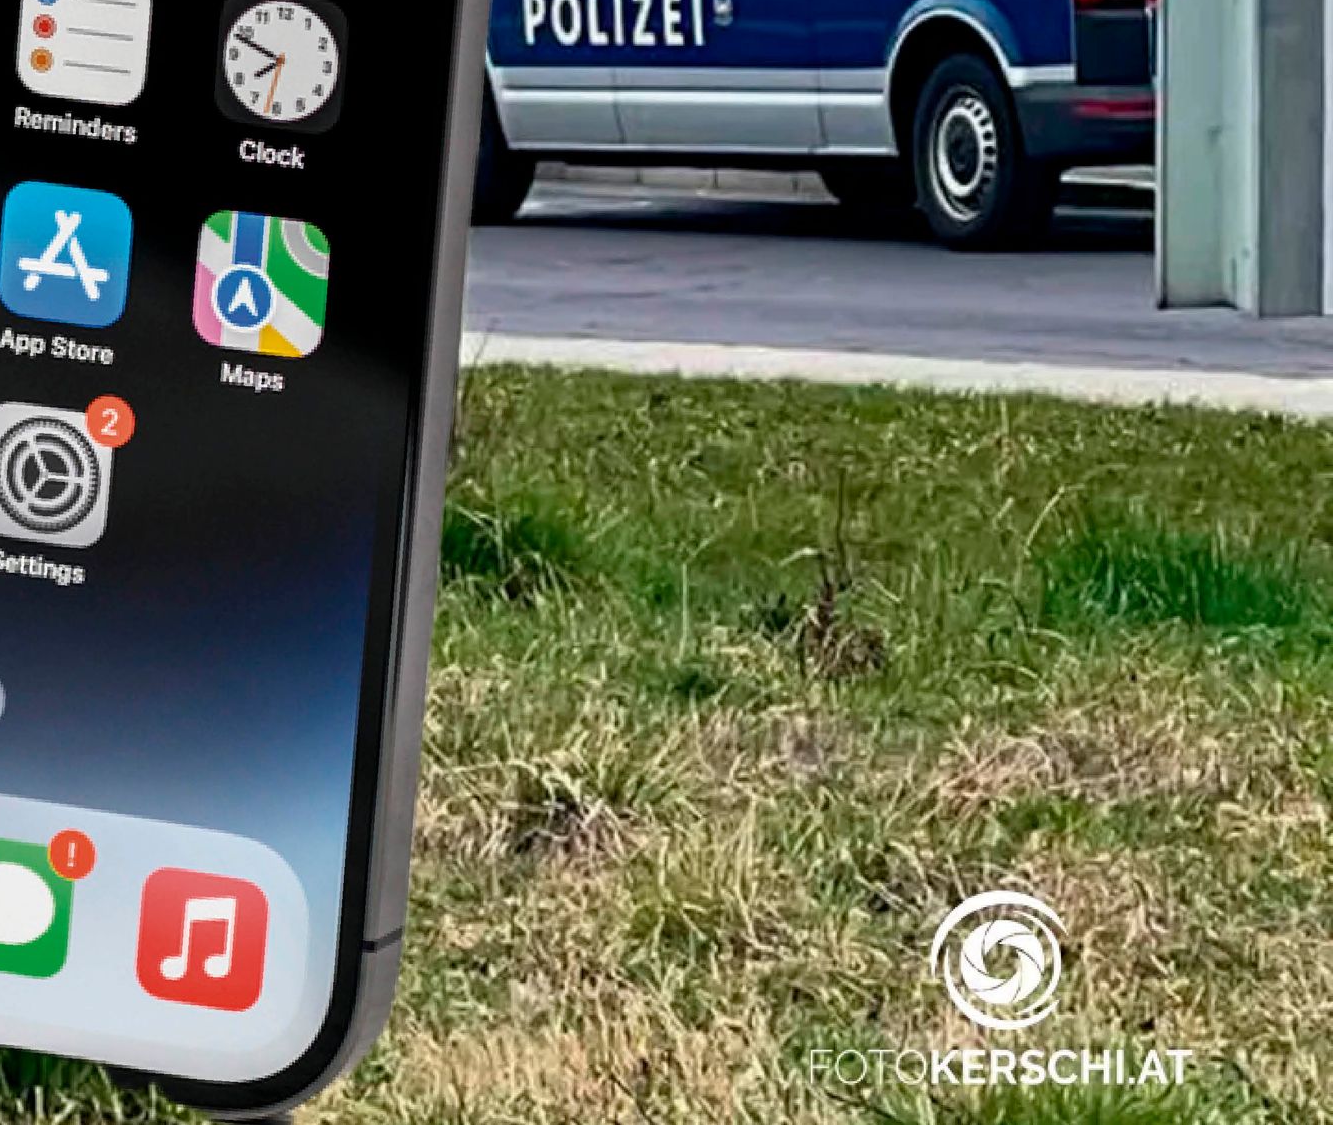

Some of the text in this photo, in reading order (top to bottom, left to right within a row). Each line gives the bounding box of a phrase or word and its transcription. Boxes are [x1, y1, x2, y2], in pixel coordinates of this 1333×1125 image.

[14, 106, 138, 144] Reminders
[239, 138, 305, 169] Clock
[0, 328, 114, 365] App Store
[220, 361, 285, 393] Maps
[100, 408, 119, 436] 2
